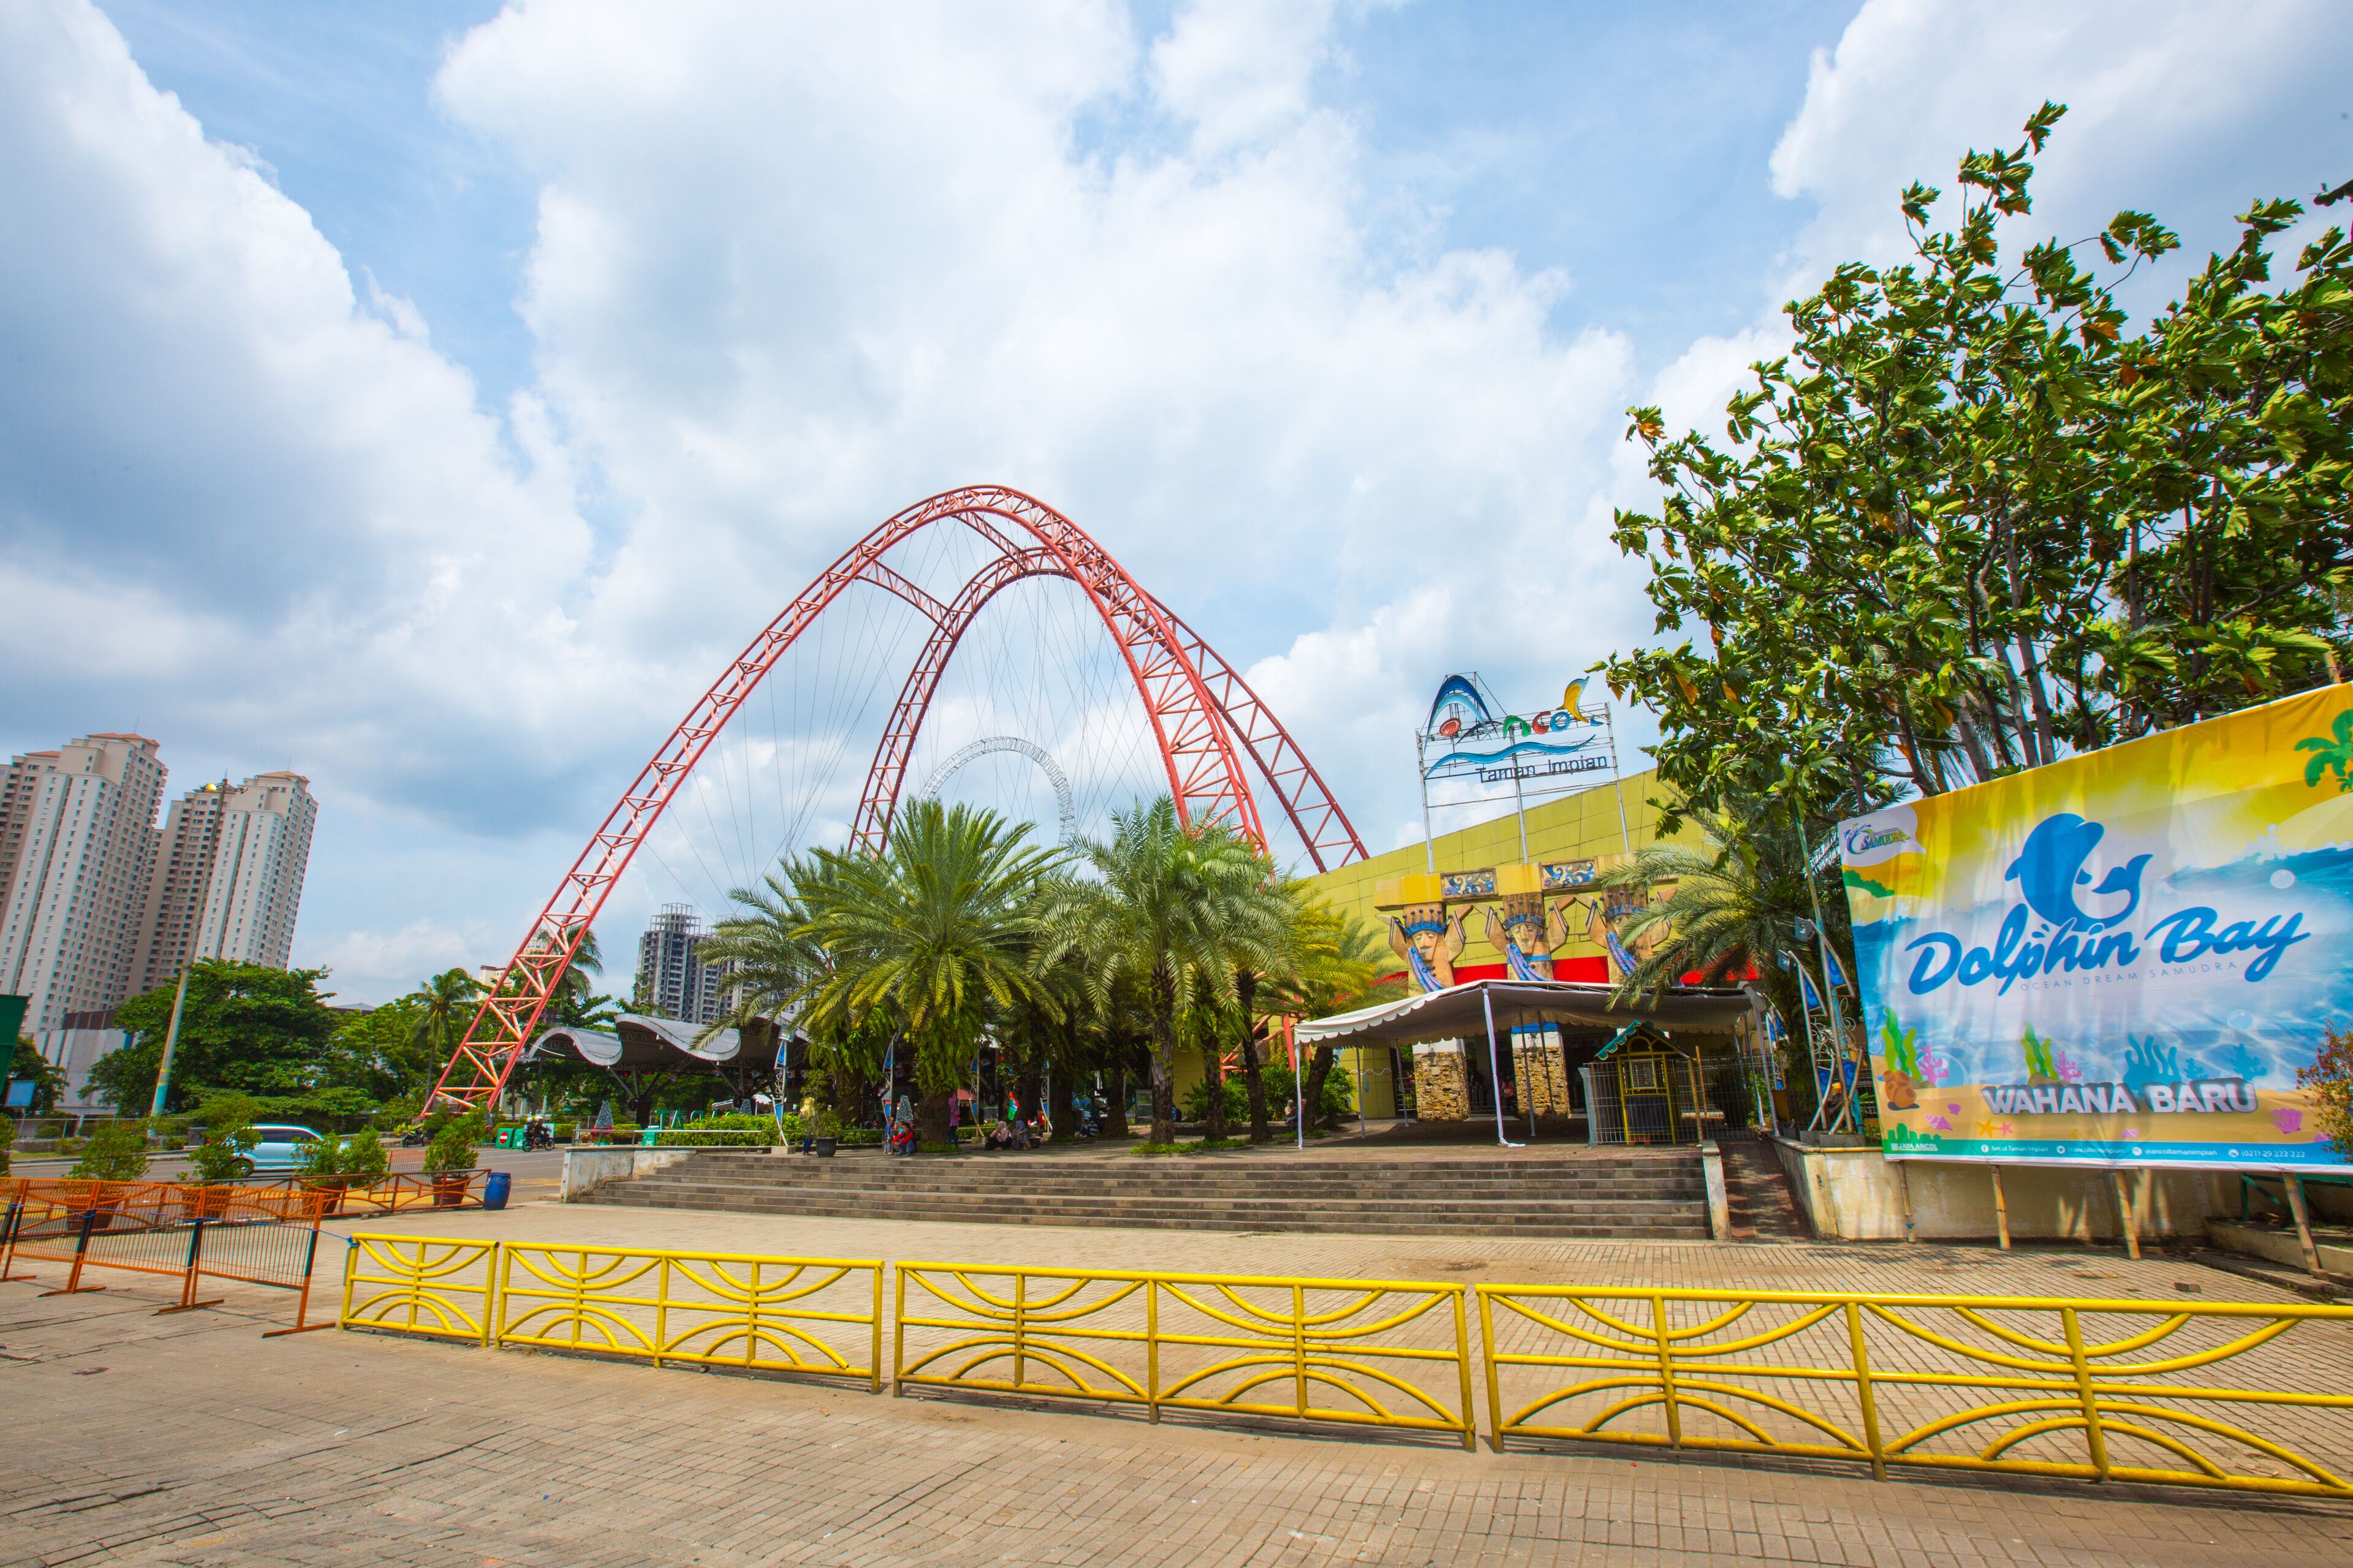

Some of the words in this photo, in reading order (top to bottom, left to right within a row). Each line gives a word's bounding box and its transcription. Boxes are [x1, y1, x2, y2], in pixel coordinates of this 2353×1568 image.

[1476, 763, 1536, 783] Taman
[1548, 755, 1607, 775] Impian
[1860, 828, 1910, 850] SAMUDRA
[1905, 903, 2140, 996] Dolphin
[2145, 906, 2311, 982] Bay
[2020, 979, 2072, 991] OCEAN
[2083, 972, 2137, 985] DREAM
[2150, 961, 2237, 978] SAMUDRA
[1982, 1083, 2139, 1115] WAHANA
[2147, 1081, 2259, 1114] BARU
